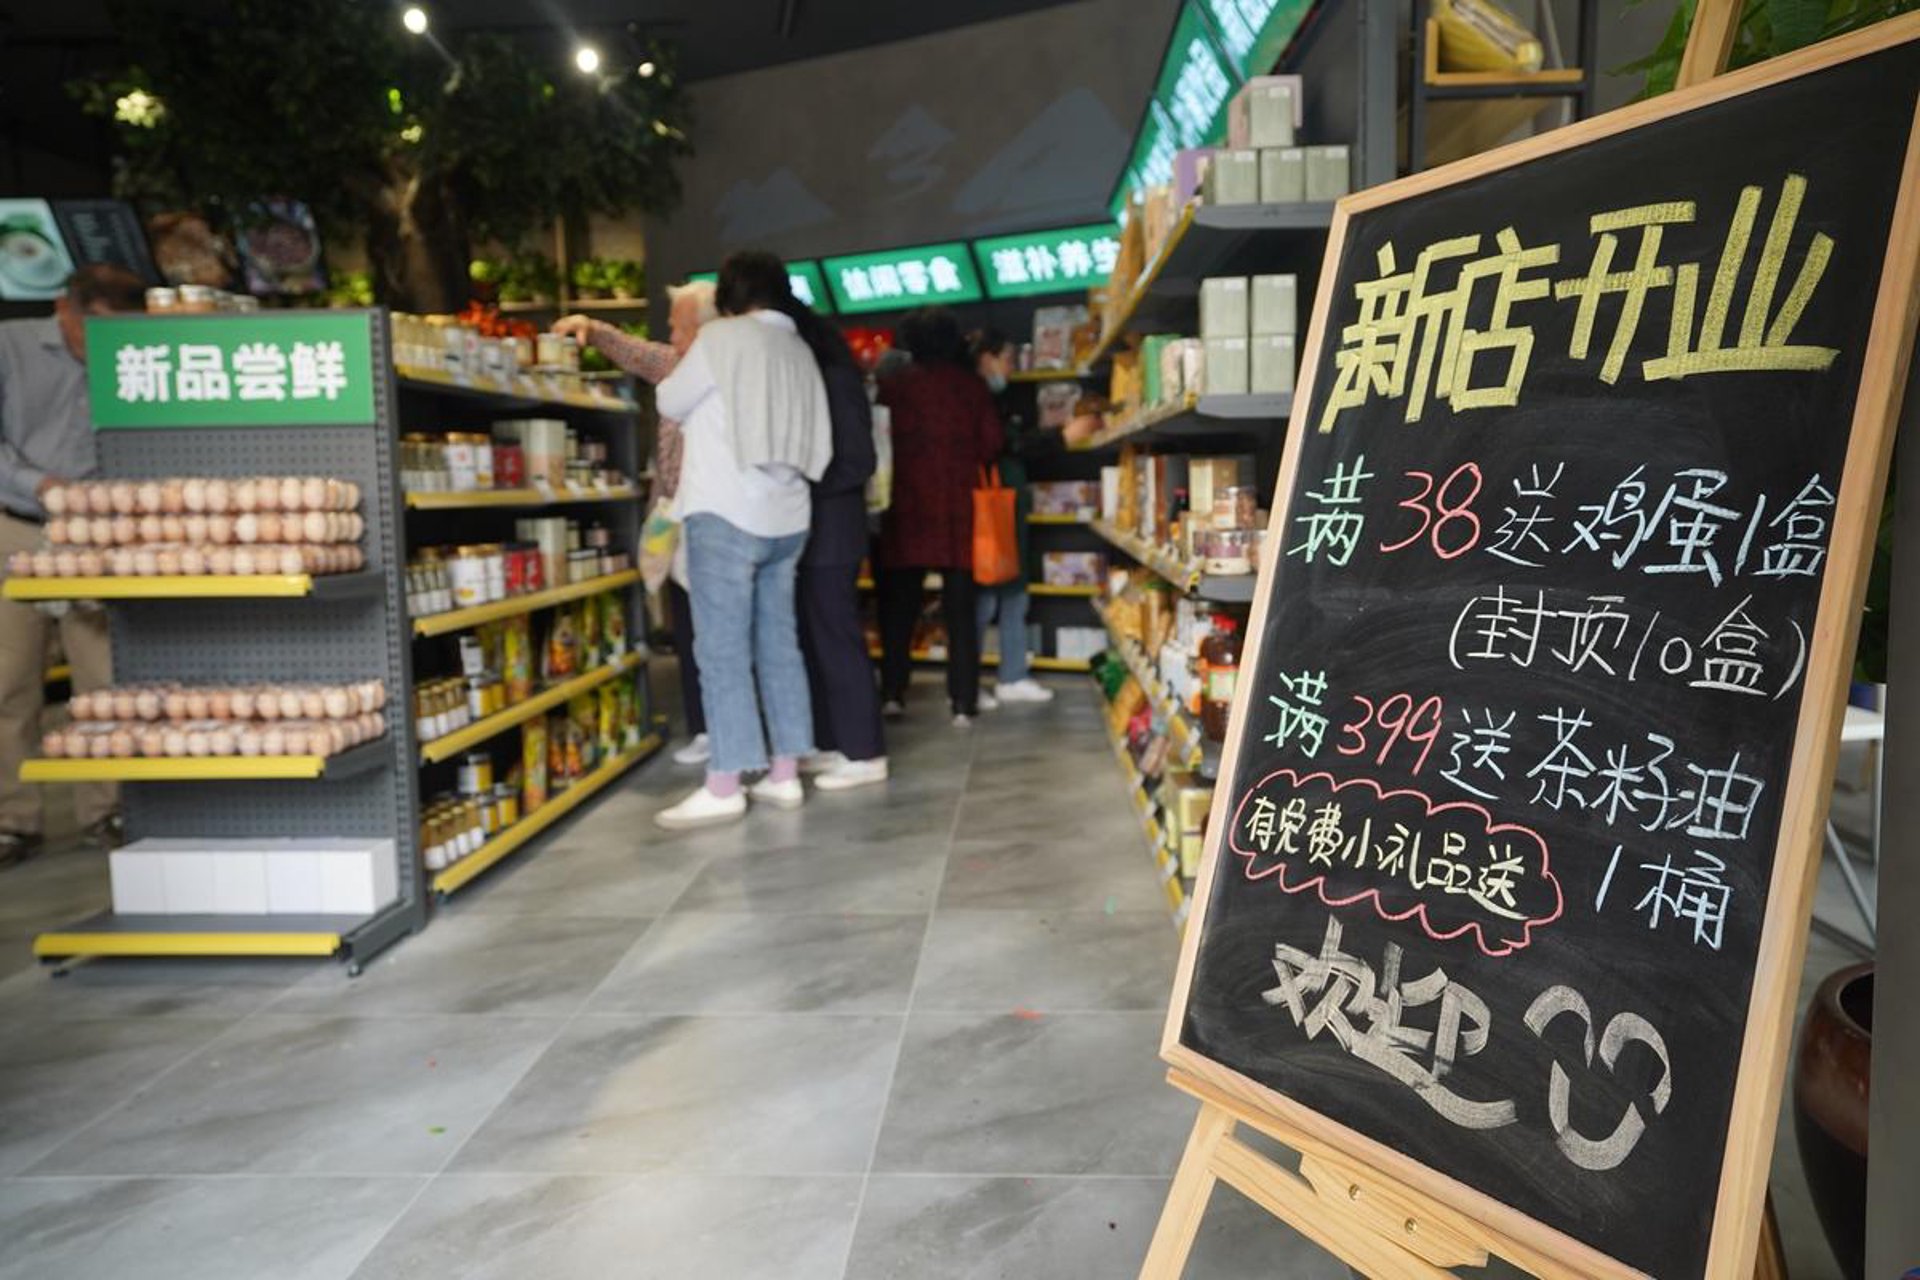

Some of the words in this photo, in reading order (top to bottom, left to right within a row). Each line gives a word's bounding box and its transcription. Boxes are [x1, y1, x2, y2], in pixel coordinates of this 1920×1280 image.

[115, 341, 347, 402] 新品尝鲜
[1319, 174, 1840, 433] 新店开业
[1246, 796, 1528, 918] 有免费小礼品送
[1261, 916, 1518, 1129] 欢迎
